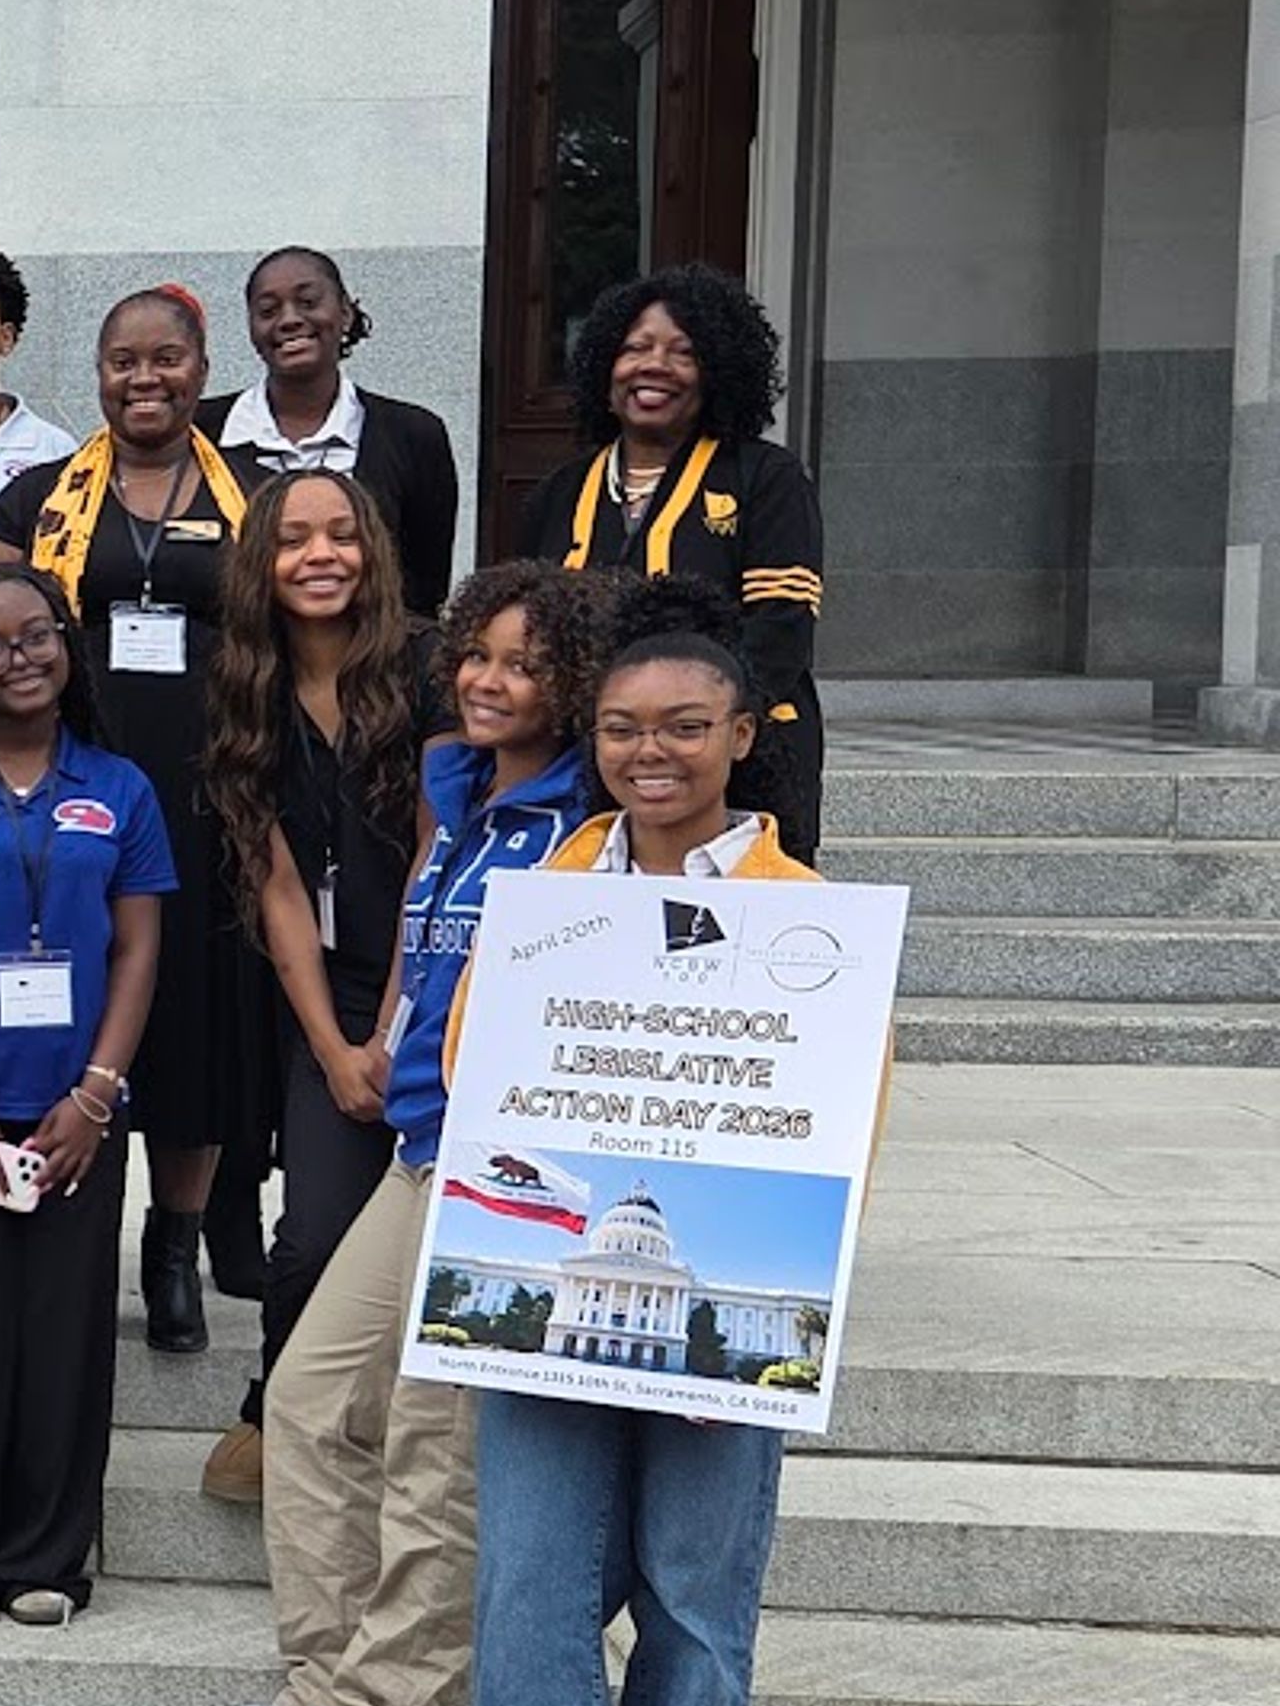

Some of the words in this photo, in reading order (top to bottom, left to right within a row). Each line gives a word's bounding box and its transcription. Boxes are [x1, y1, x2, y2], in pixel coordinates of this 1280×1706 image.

[509, 933, 558, 963] April
[562, 913, 612, 945] 20th
[653, 956, 721, 972] NCBW
[543, 997, 798, 1043] HIGH-SCHOOL
[550, 1044, 775, 1089] LEGISLATIVE
[498, 1086, 634, 1124] ACTION
[640, 1096, 717, 1130] DAY
[717, 1103, 814, 1139] 2026
[588, 1132, 653, 1154] Room
[659, 1137, 697, 1159] 115
